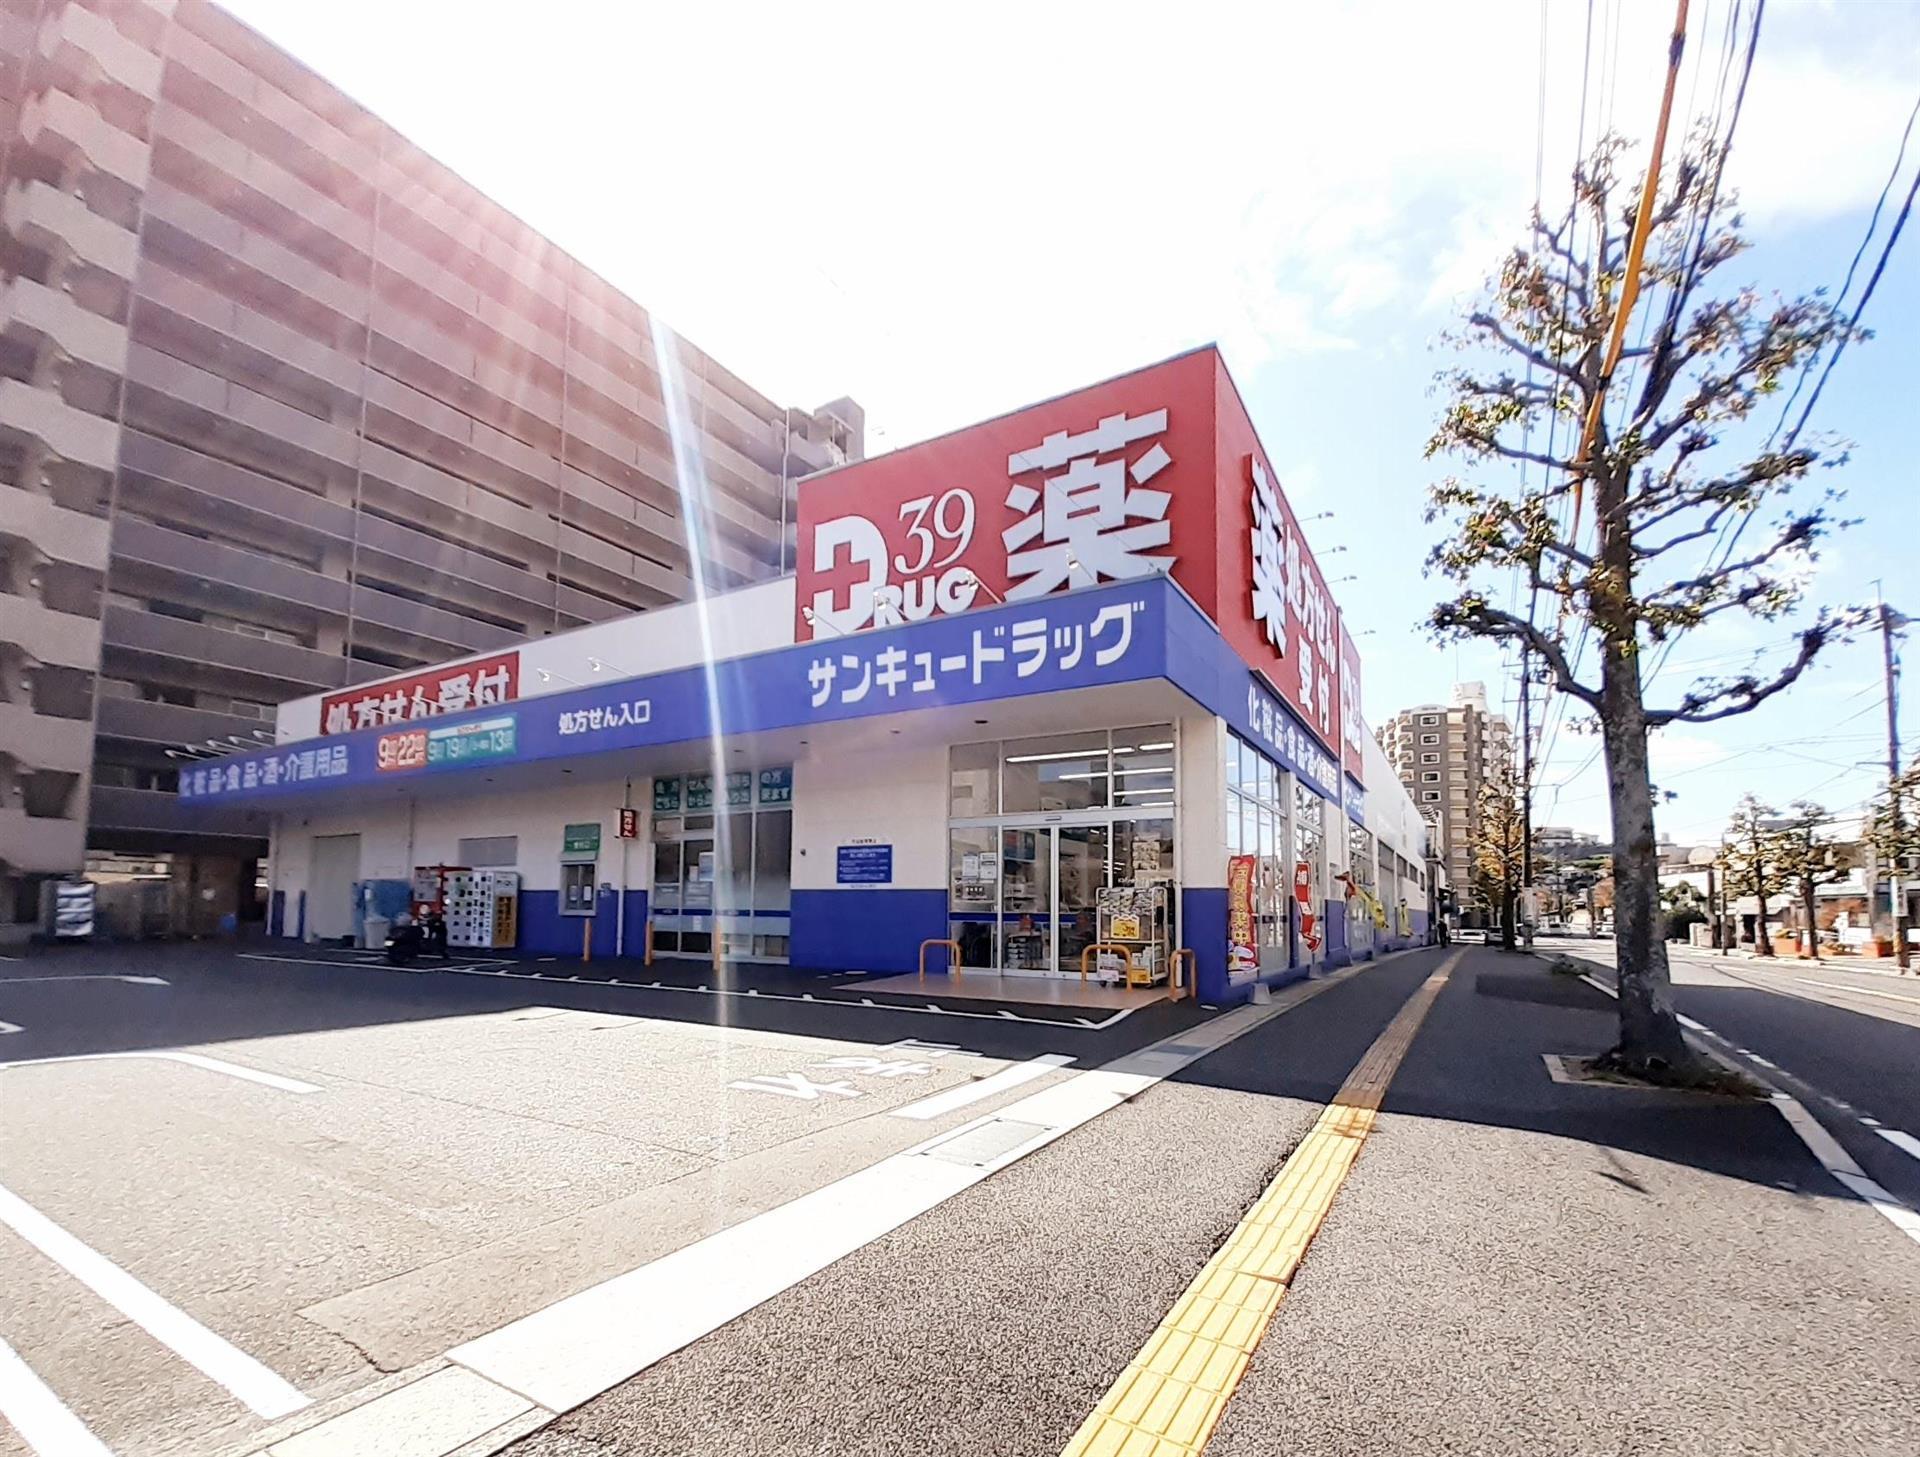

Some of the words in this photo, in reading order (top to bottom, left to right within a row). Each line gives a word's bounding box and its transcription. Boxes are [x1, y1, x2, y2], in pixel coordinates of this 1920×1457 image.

[893, 487, 977, 574] 39
[1001, 407, 1176, 602] 薬
[1250, 453, 1288, 660] 薬
[808, 601, 1146, 708] サンキュードラッグ
[558, 699, 651, 735] 処方せん入口
